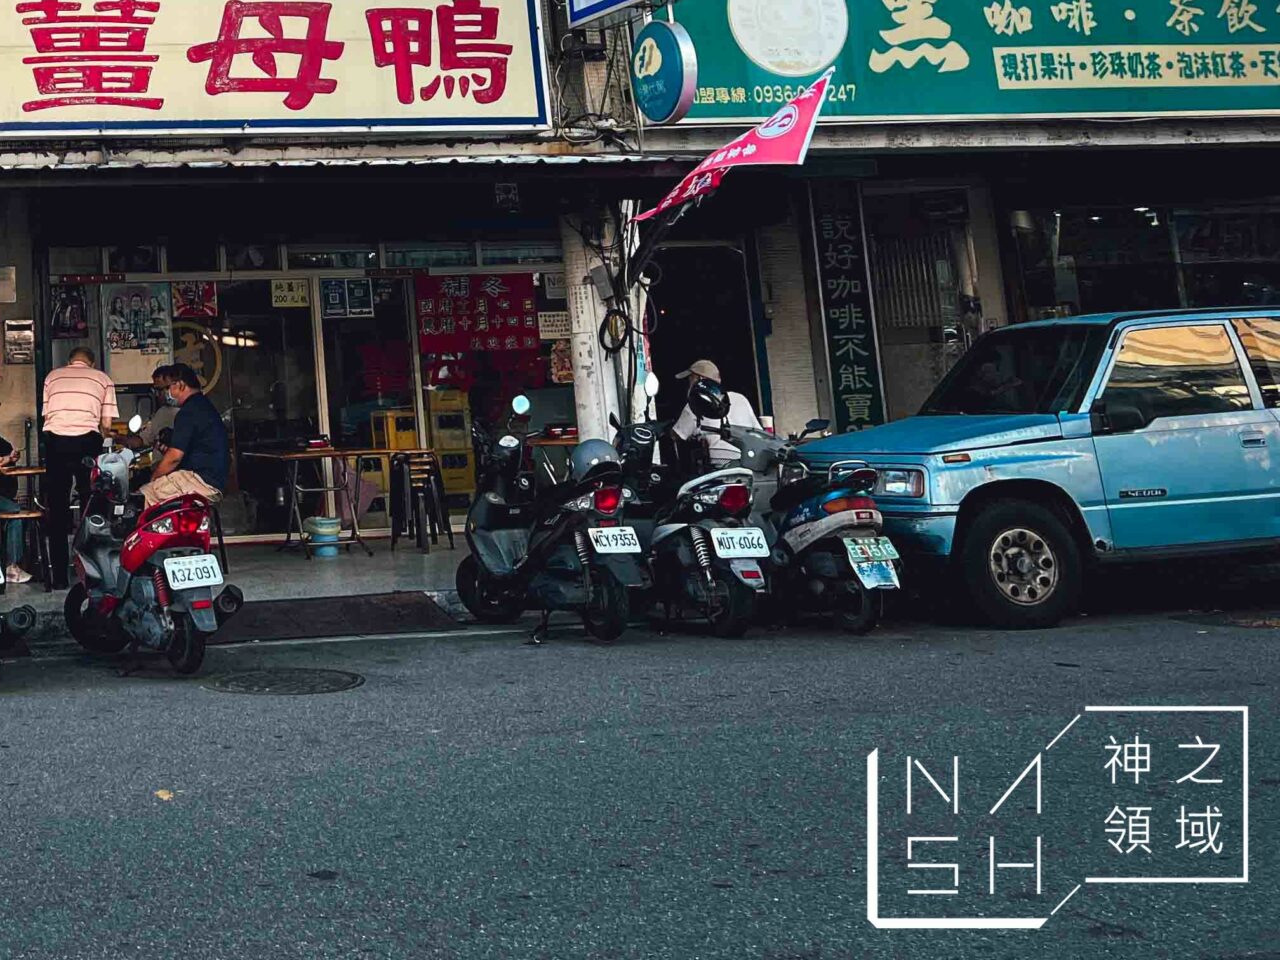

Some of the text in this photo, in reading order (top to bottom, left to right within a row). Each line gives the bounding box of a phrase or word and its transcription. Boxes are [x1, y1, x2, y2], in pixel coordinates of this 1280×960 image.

[1000, 51, 1280, 81] 現打果汁·珍珠奶茶·泡沫紅茶·天
